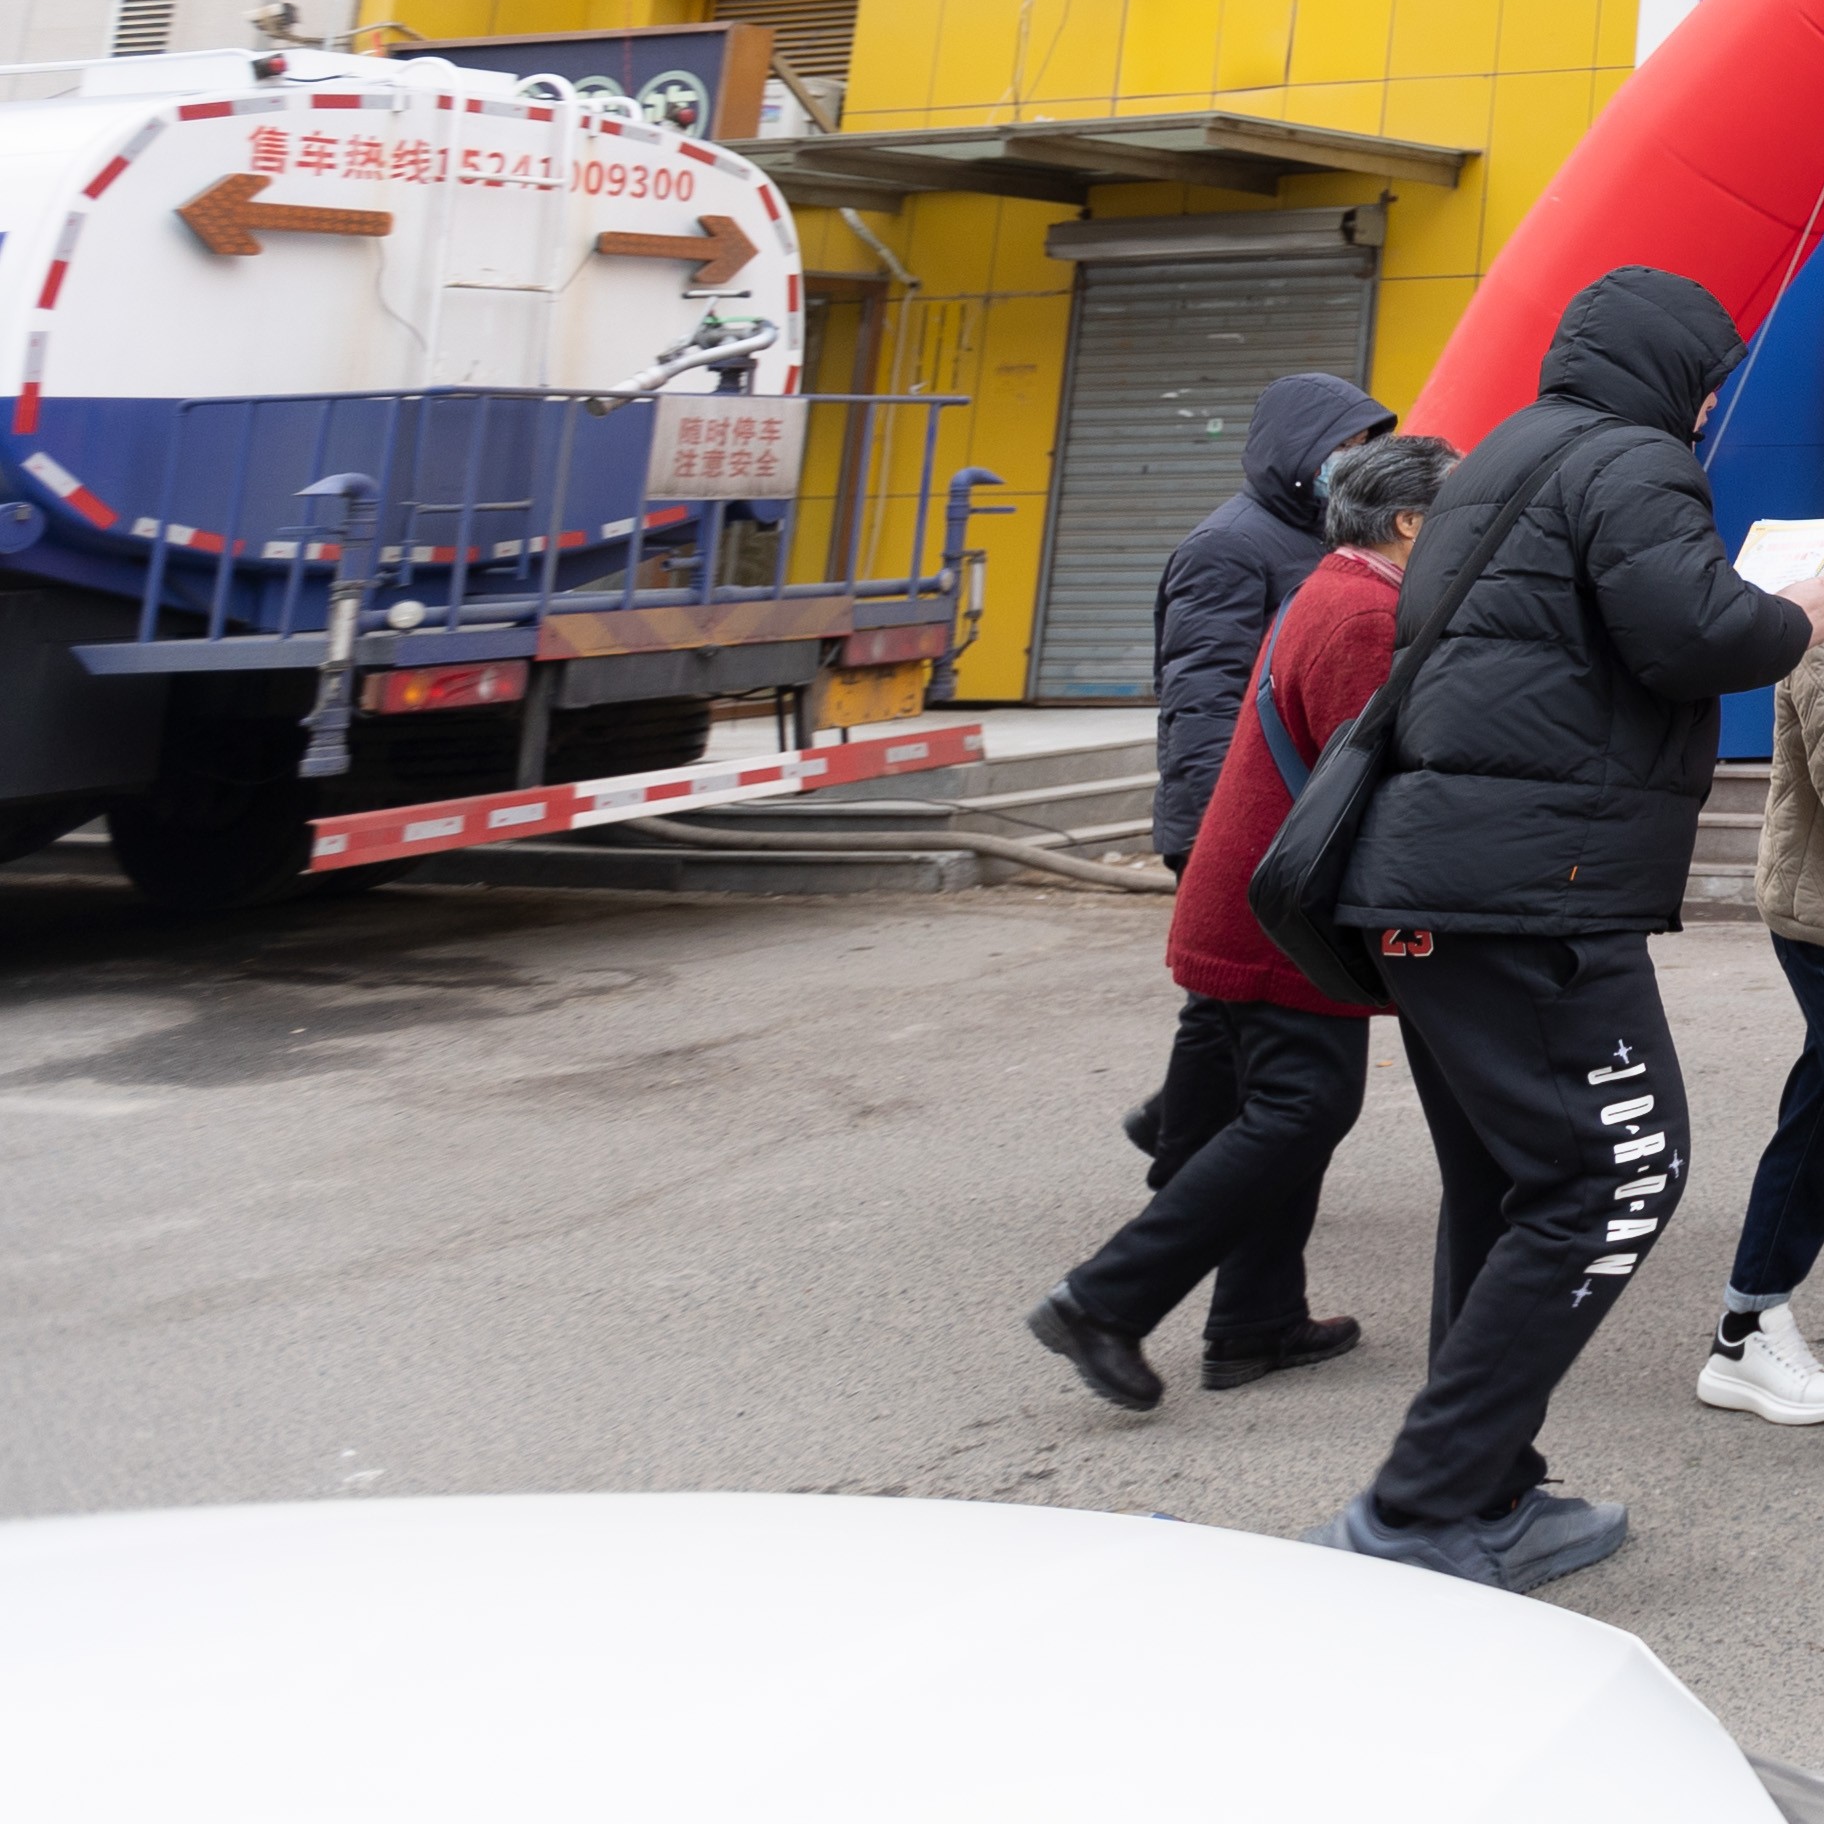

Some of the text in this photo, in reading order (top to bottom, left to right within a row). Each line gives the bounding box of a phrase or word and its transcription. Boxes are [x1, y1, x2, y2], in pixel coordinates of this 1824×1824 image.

[678, 415, 784, 446] 随时停车
[673, 448, 780, 478] 注意安全
[1583, 1062, 1668, 1275] JORDAN
